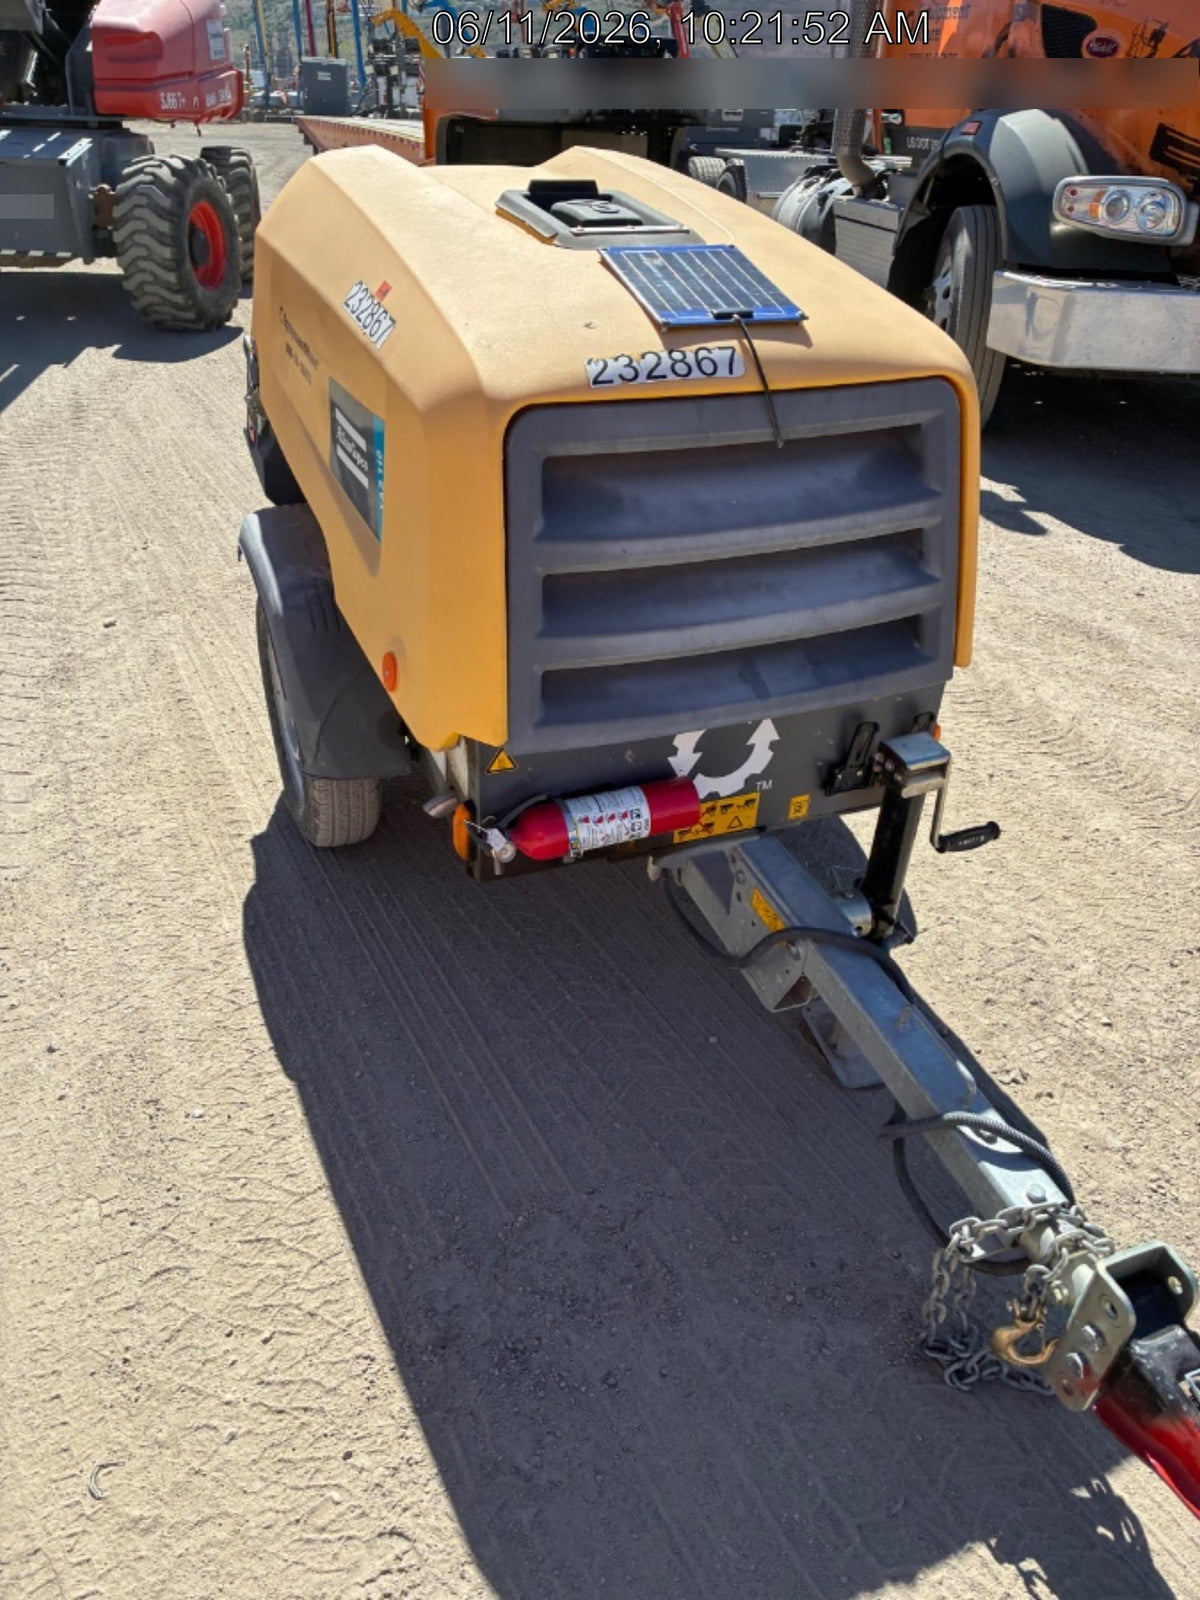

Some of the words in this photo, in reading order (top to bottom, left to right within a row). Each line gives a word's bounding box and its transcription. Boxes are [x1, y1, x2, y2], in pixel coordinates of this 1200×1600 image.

[344, 280, 396, 343] 232867
[587, 346, 736, 386] 232867
[755, 780, 772, 791] TM
